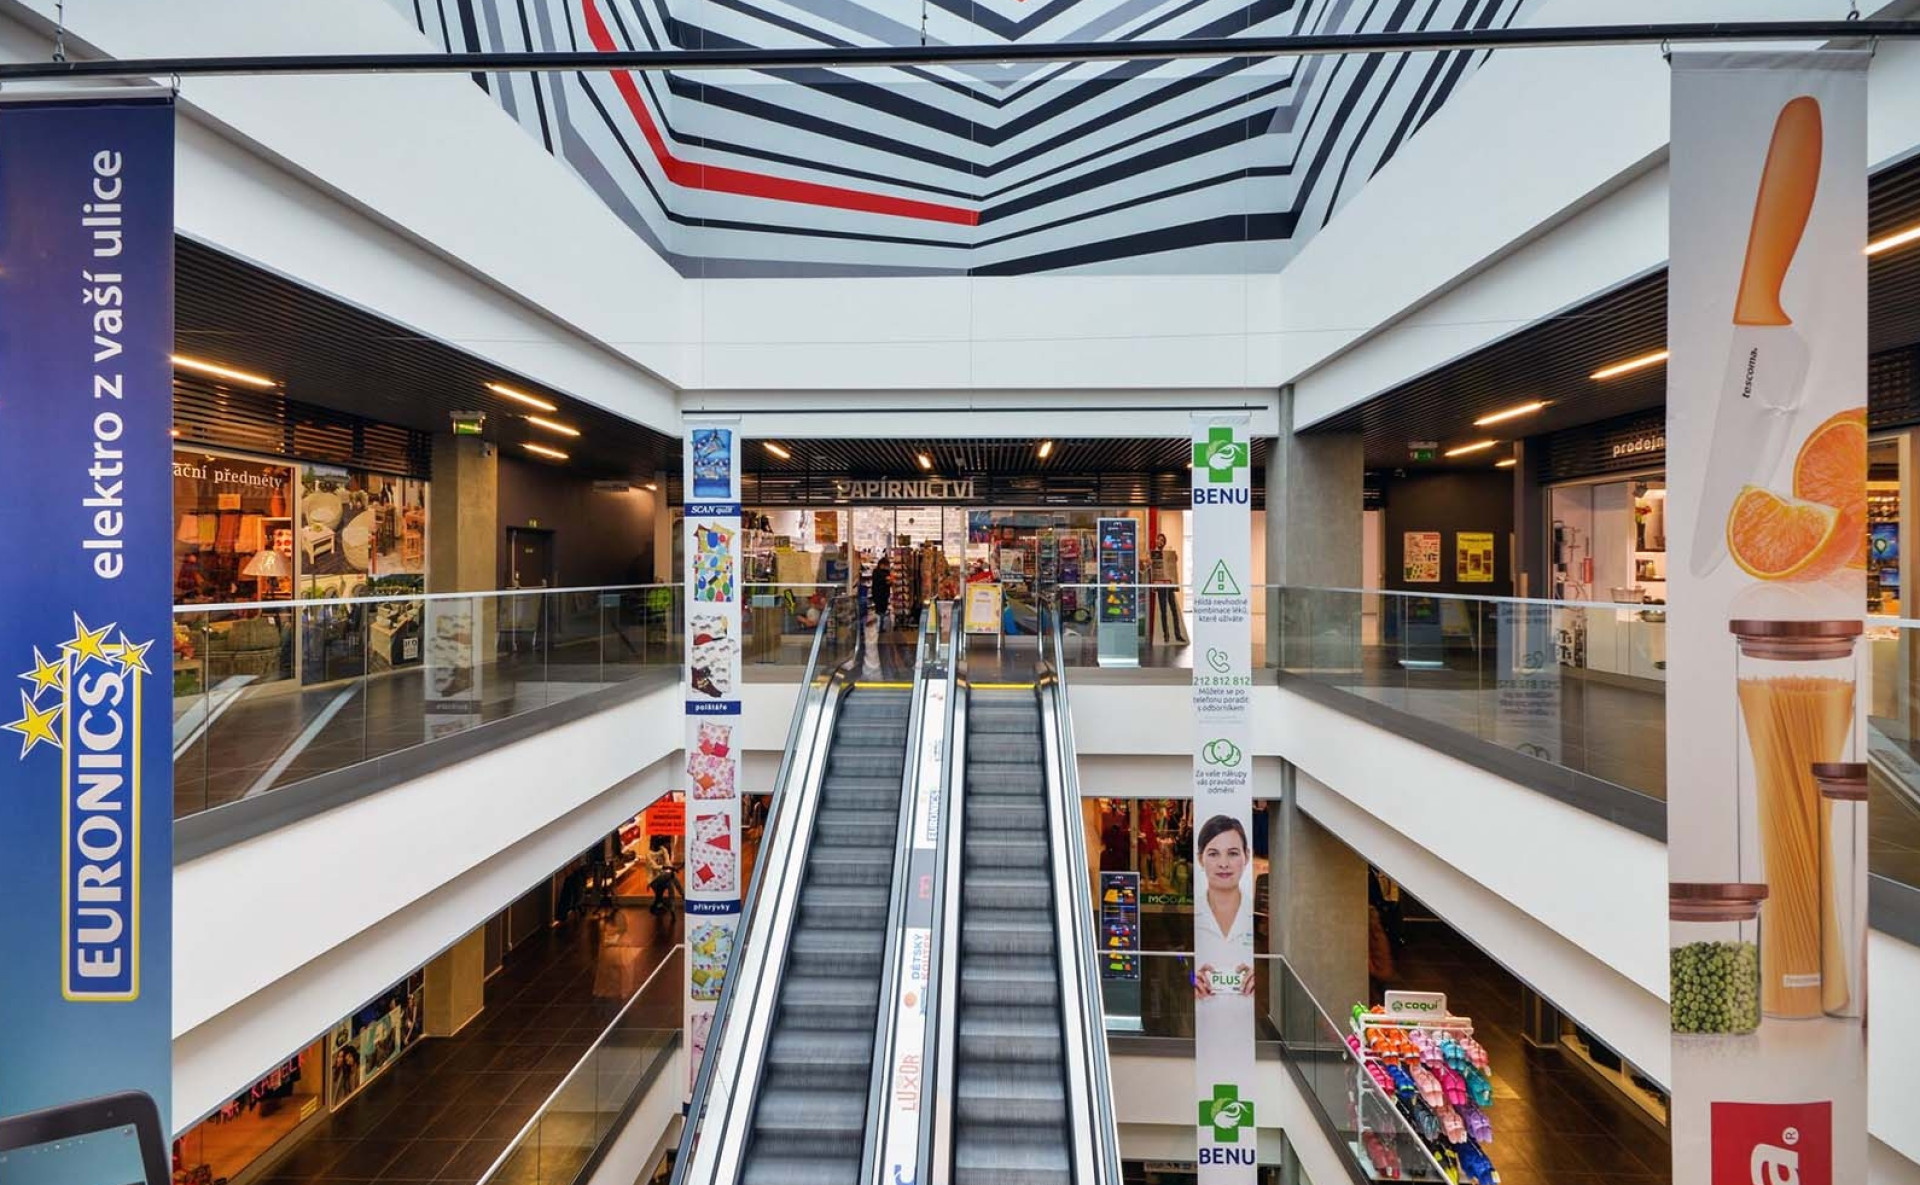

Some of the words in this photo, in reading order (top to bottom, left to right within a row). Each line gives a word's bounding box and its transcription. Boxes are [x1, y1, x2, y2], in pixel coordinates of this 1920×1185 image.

[82, 150, 123, 257] ulice
[82, 270, 123, 362] vaší
[93, 374, 123, 399] z
[82, 411, 123, 579] elektro
[1193, 488, 1248, 504] BENU
[691, 505, 715, 514] SCAN
[1193, 676, 1210, 686] 212
[1213, 676, 1230, 686] 812
[1233, 676, 1250, 686] 812
[76, 671, 124, 979] EURONICS
[911, 934, 924, 980] DĚTSKÝ
[1212, 975, 1240, 985] PLUS
[1405, 1000, 1438, 1012] coqui
[895, 1054, 920, 1112] LUXOR
[1199, 1148, 1255, 1165] BENU
